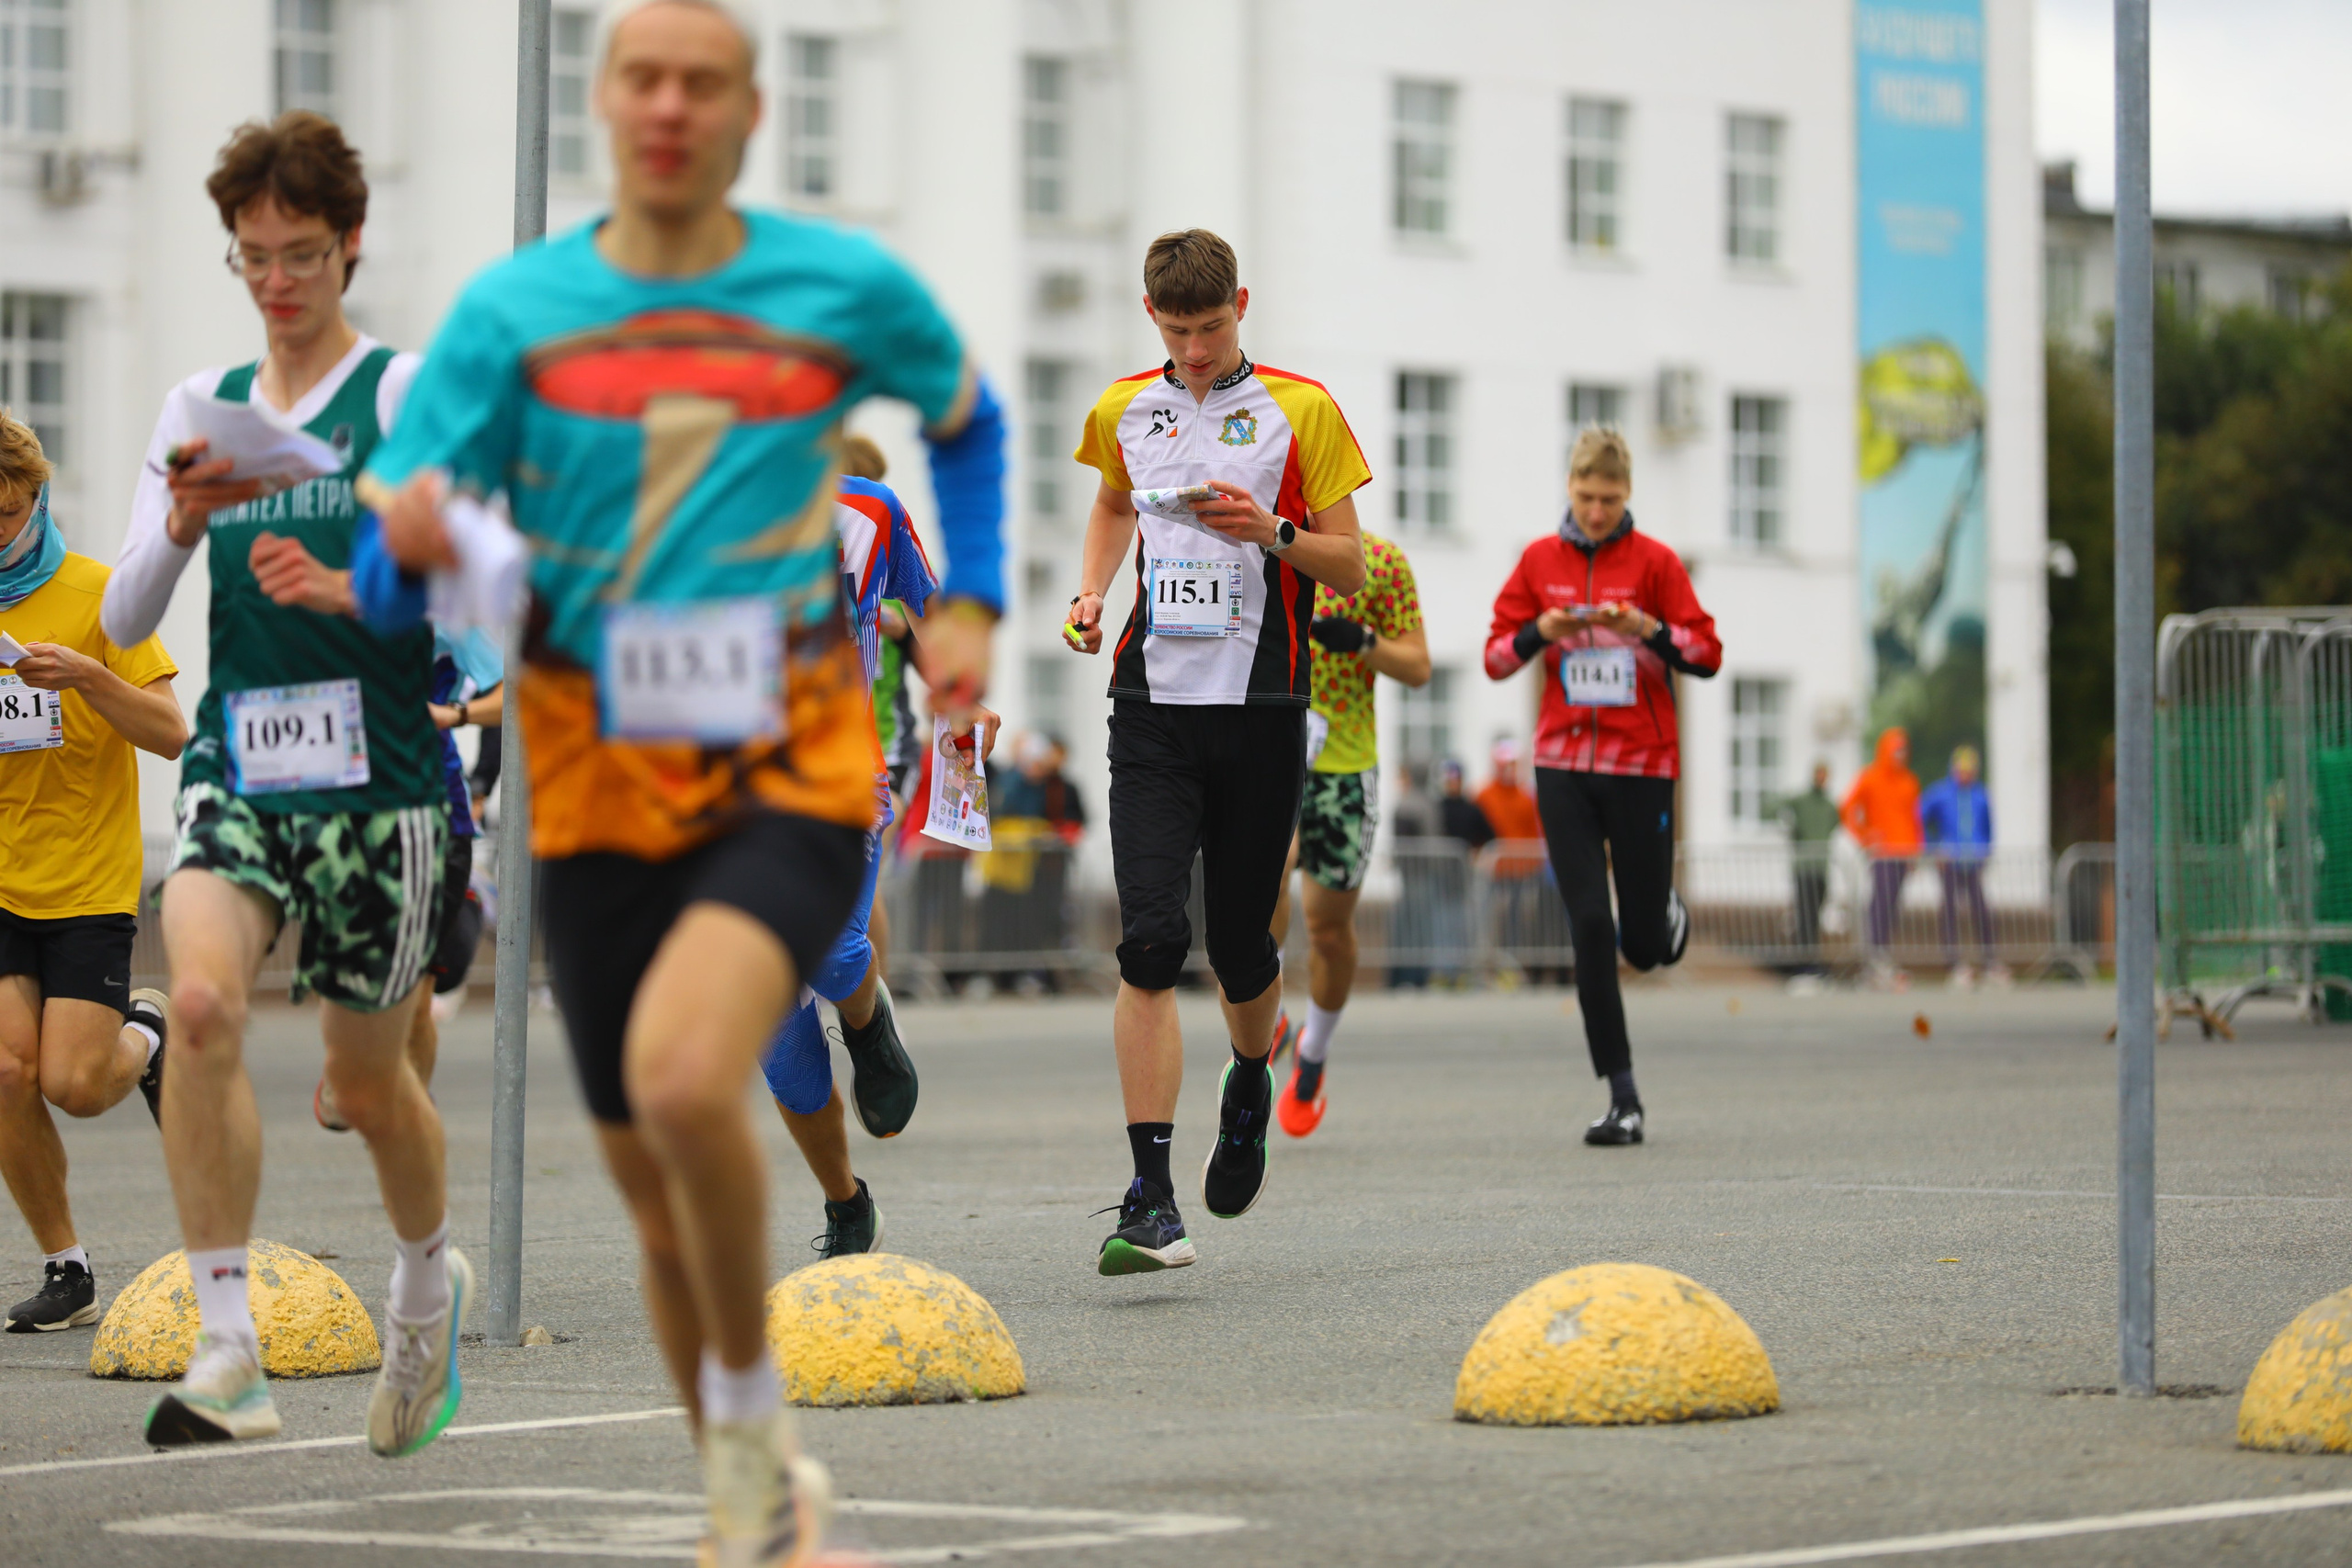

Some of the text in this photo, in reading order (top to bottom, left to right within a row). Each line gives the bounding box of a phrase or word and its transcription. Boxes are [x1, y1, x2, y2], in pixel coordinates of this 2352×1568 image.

[291, 478, 356, 520] ПЕТРА
[1158, 580, 1221, 604] 115.1
[1571, 663, 1619, 684] 114.1
[246, 711, 334, 751] 109.1
